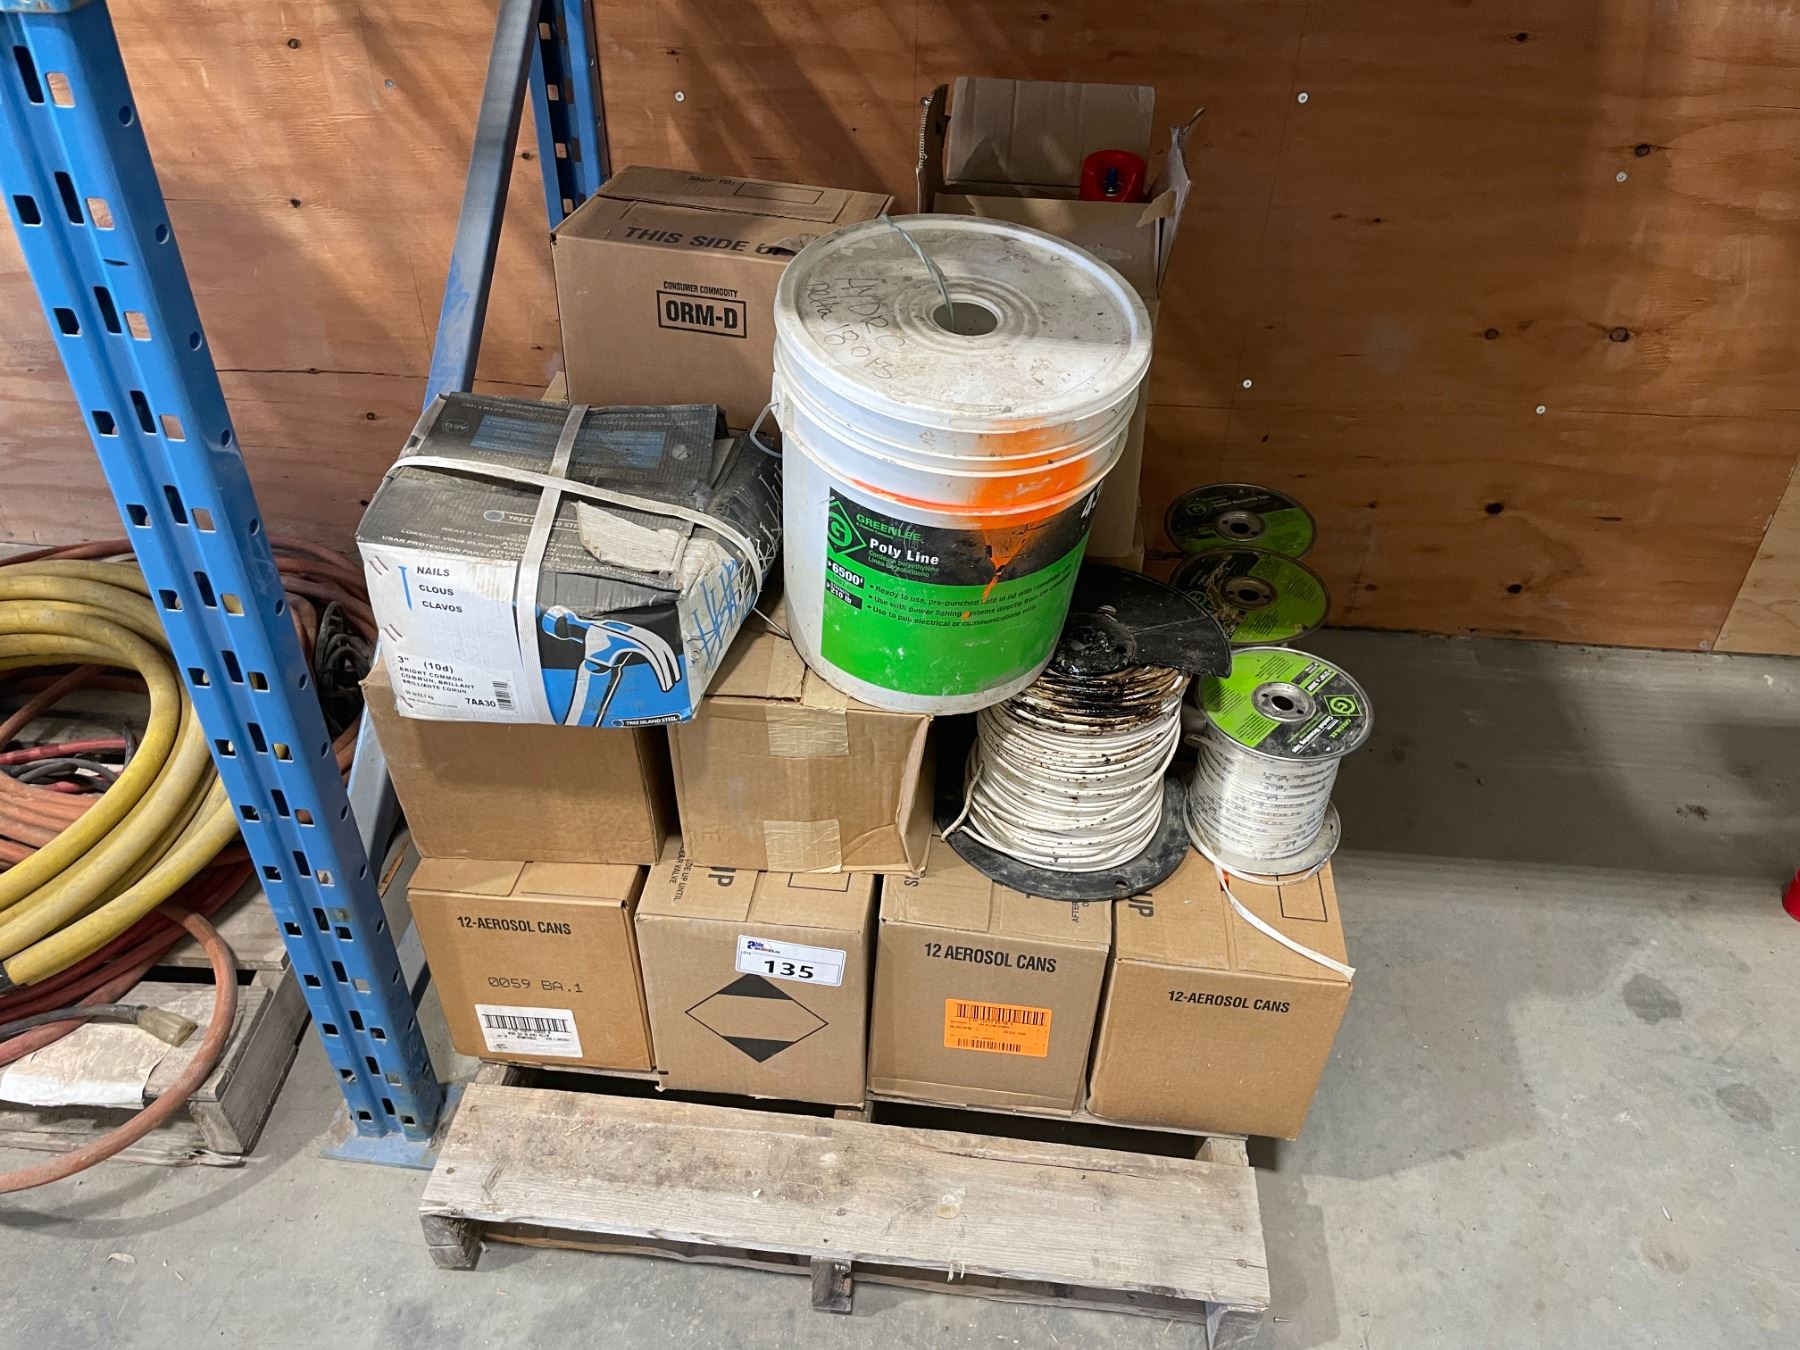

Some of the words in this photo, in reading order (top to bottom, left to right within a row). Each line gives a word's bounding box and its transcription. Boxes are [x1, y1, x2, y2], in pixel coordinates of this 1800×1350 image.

[624, 226, 683, 244] THIS
[688, 234, 750, 252] SIDE
[663, 281, 699, 293] CONSUMER
[699, 285, 738, 298] COMMODITY
[665, 299, 738, 330] ORM-D
[855, 513, 922, 541] GREENLEE
[869, 537, 902, 559] Poly
[906, 549, 940, 565] Line
[416, 565, 451, 577] NAILS
[418, 584, 455, 596] CLOUS
[421, 599, 463, 614] CLAVOS
[873, 595, 889, 607] Use
[872, 606, 887, 616] Use
[888, 611, 897, 619] to
[914, 618, 950, 627] electrical
[951, 620, 961, 628] or
[423, 661, 454, 674] (10d)
[428, 672, 463, 682] COMMON
[438, 680, 475, 689] BRILLANT
[464, 697, 497, 708] 7AA30
[668, 864, 681, 885] VALVE
[456, 915, 536, 934] 12-AEROSOL
[537, 920, 573, 936] CANS
[923, 942, 942, 959] 12
[943, 947, 1013, 969] AEROSOL
[1016, 954, 1057, 974] CANS
[764, 960, 815, 979] 135
[487, 976, 532, 990] 0059
[1167, 989, 1251, 1010] 12-AEROSOL
[1252, 998, 1291, 1014] CANS
